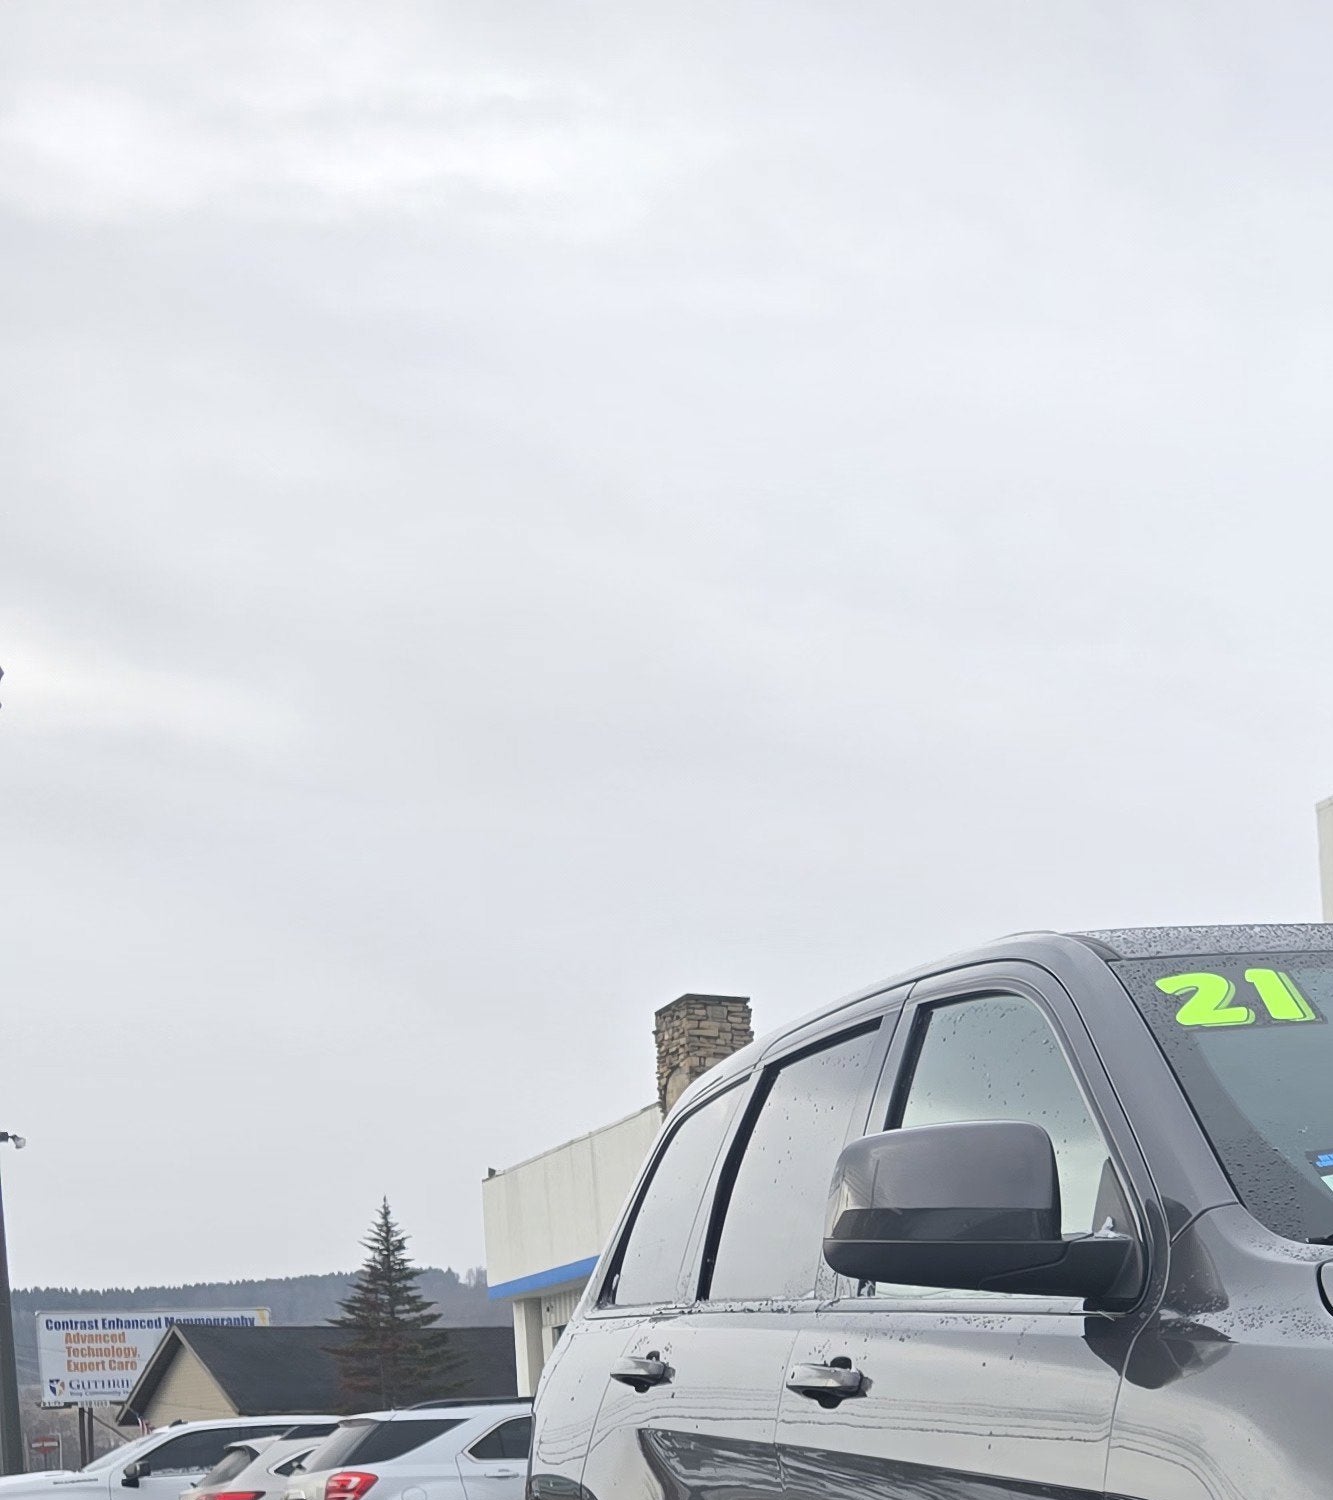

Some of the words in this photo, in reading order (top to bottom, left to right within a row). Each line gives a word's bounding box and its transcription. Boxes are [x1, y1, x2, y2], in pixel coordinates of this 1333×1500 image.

[1155, 968, 1316, 1027] 21
[45, 1318, 99, 1331] Contrast
[101, 1317, 162, 1330] Enhanced
[65, 1331, 126, 1344] Advanced
[66, 1359, 106, 1373] Expert
[108, 1359, 138, 1371] Care
